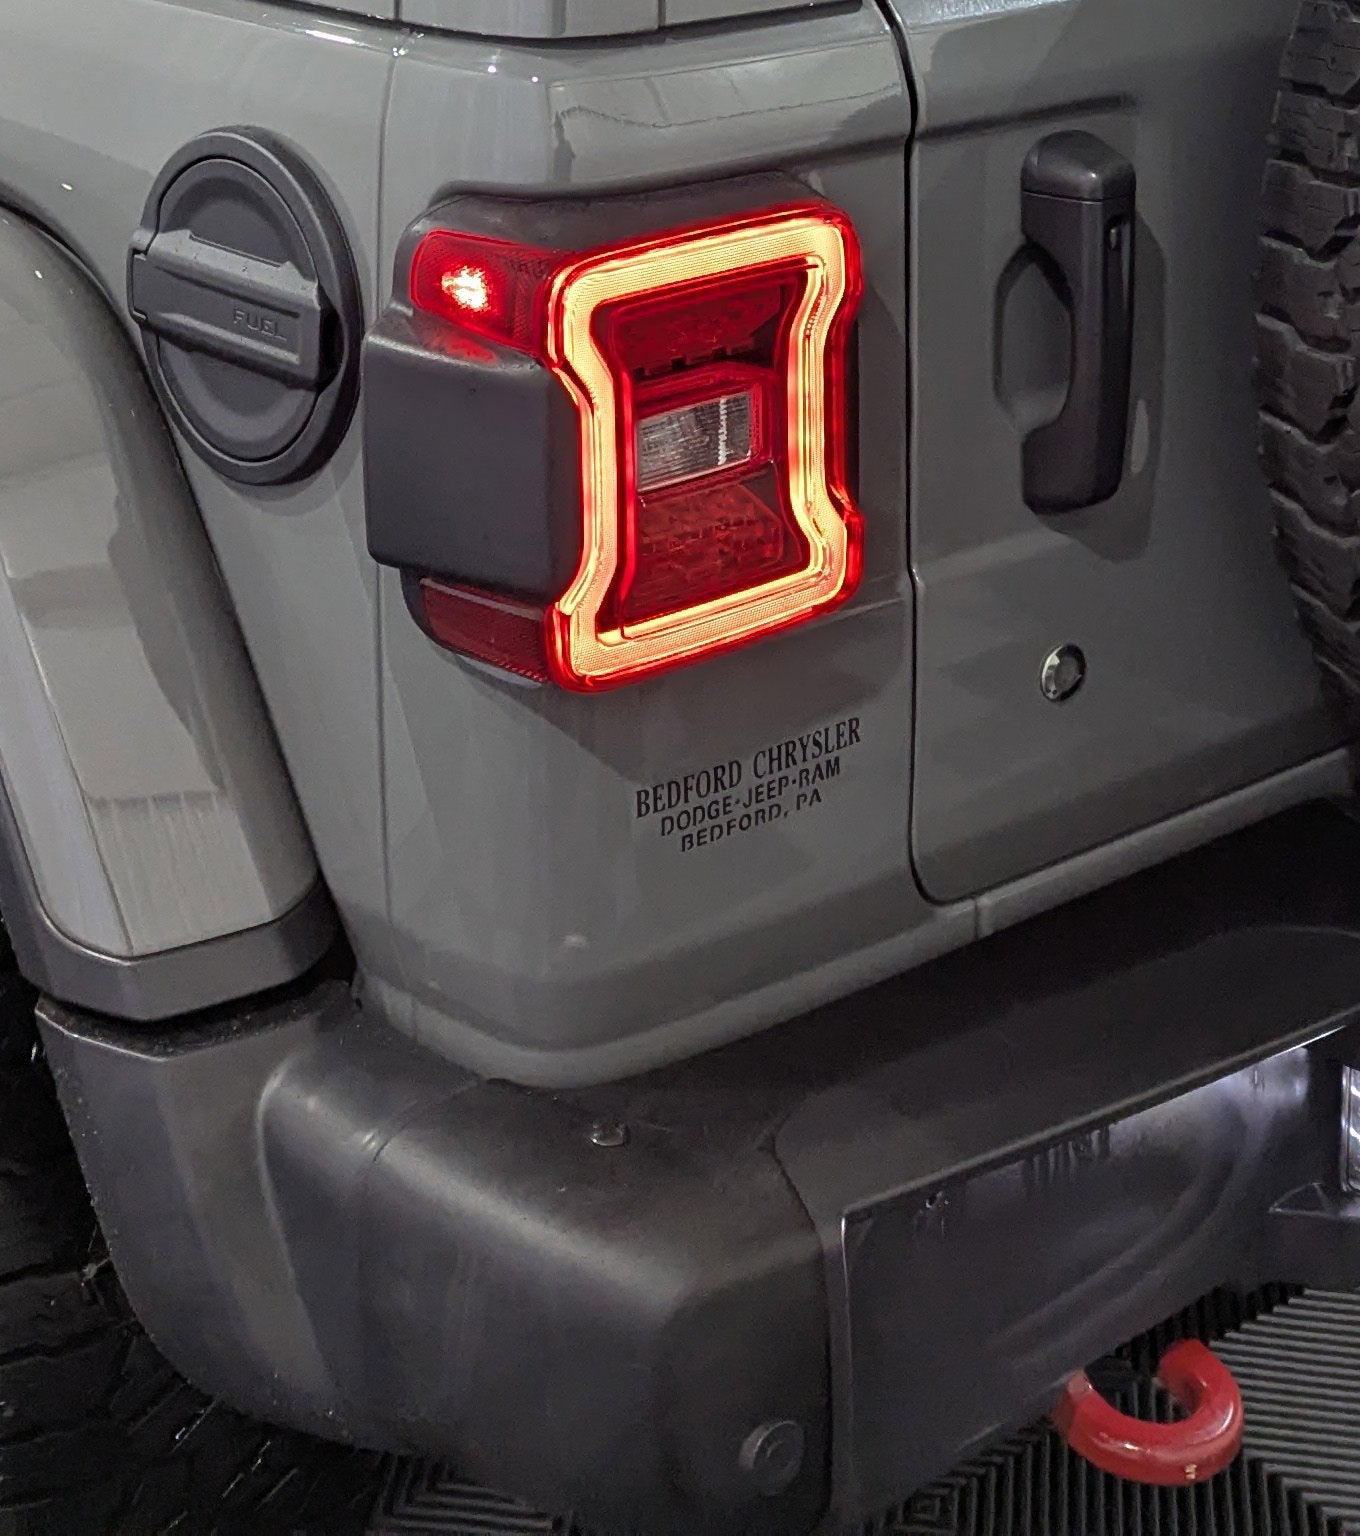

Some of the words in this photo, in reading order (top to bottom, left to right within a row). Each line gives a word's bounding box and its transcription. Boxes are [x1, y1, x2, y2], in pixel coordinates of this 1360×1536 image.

[233, 308, 288, 342] FUEL
[635, 759, 743, 819] BEDFORD
[753, 716, 862, 780] CHRYSLER
[680, 803, 789, 853] BEDFORD,
[795, 787, 823, 812] PA
